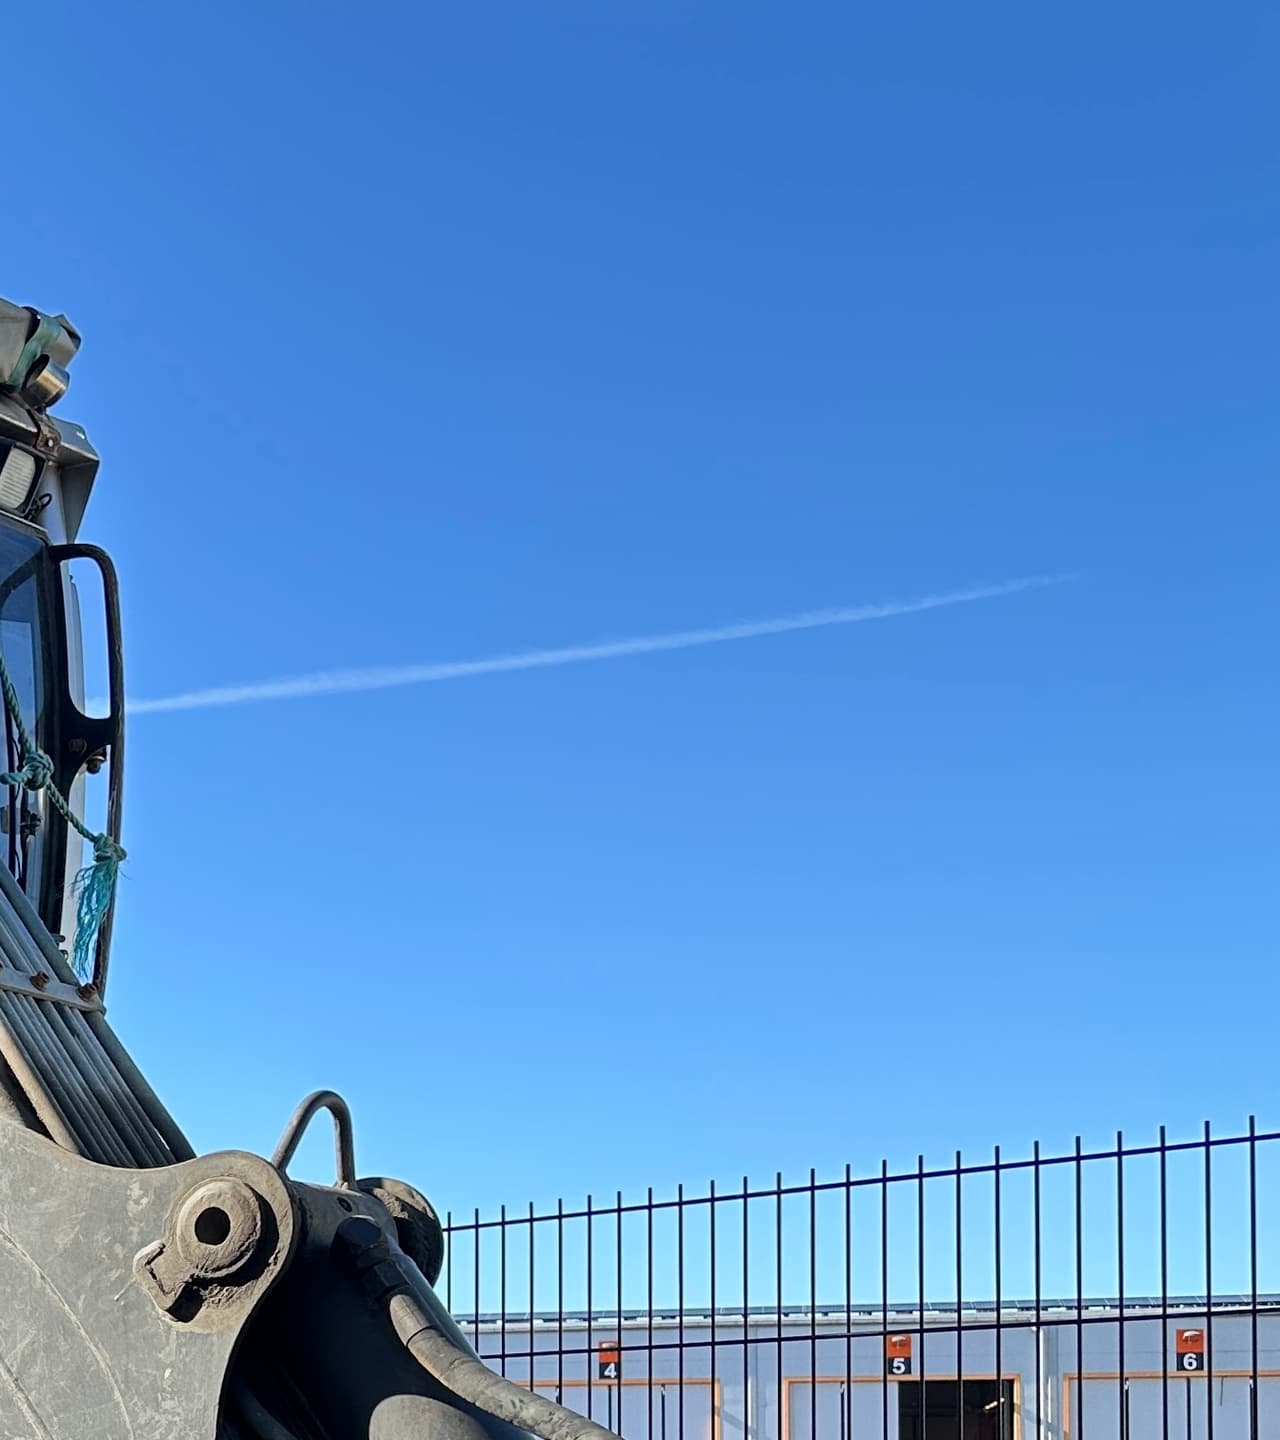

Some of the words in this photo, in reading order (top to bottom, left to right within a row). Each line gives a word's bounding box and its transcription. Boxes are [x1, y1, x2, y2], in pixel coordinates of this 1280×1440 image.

[892, 1357, 906, 1375] 5
[1182, 1352, 1198, 1370] 6
[603, 1362, 617, 1379] 4
